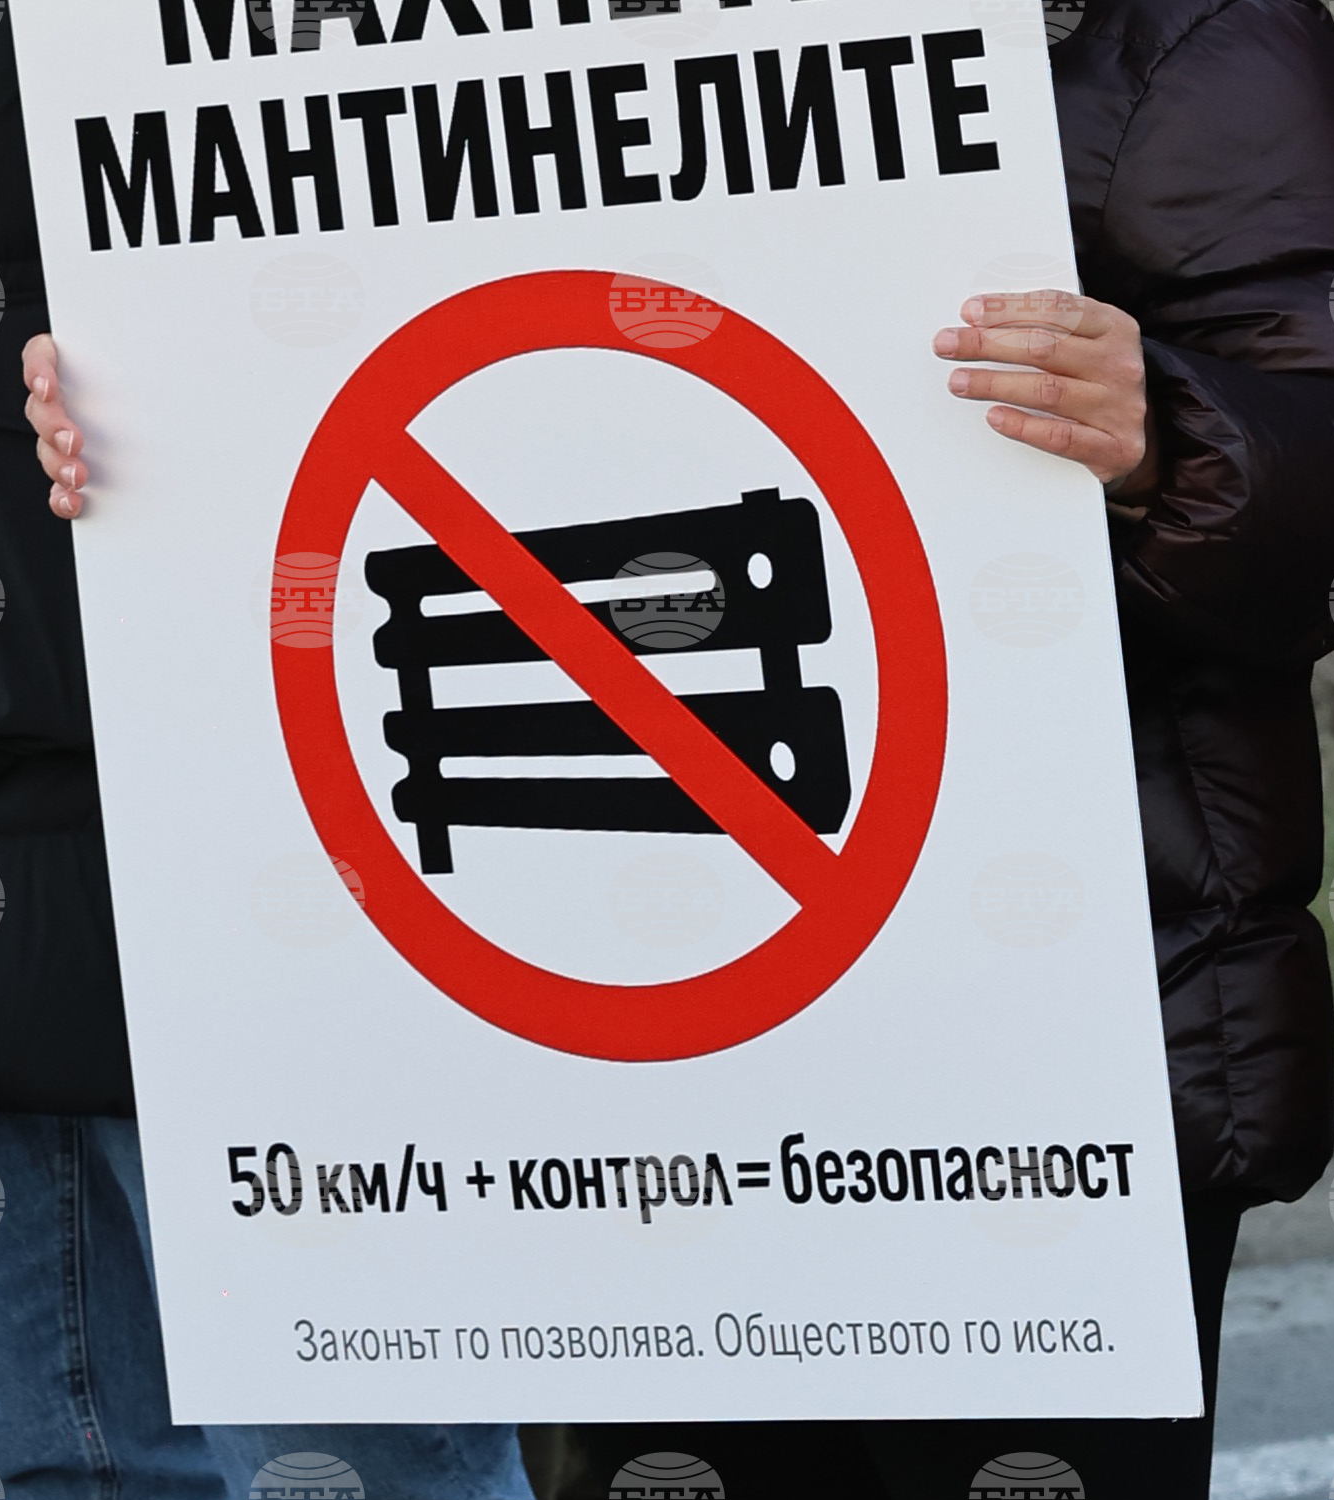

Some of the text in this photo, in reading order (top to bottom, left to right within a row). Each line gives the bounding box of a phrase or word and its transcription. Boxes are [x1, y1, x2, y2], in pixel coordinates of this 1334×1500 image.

[75, 30, 1000, 251] МАНТИНЕЛИТЕ
[228, 1143, 302, 1216] 50
[317, 1144, 447, 1213] км/ч
[466, 1161, 495, 1198] +
[295, 1313, 1114, 1363] Законът го позволява. Обществото го иска.
